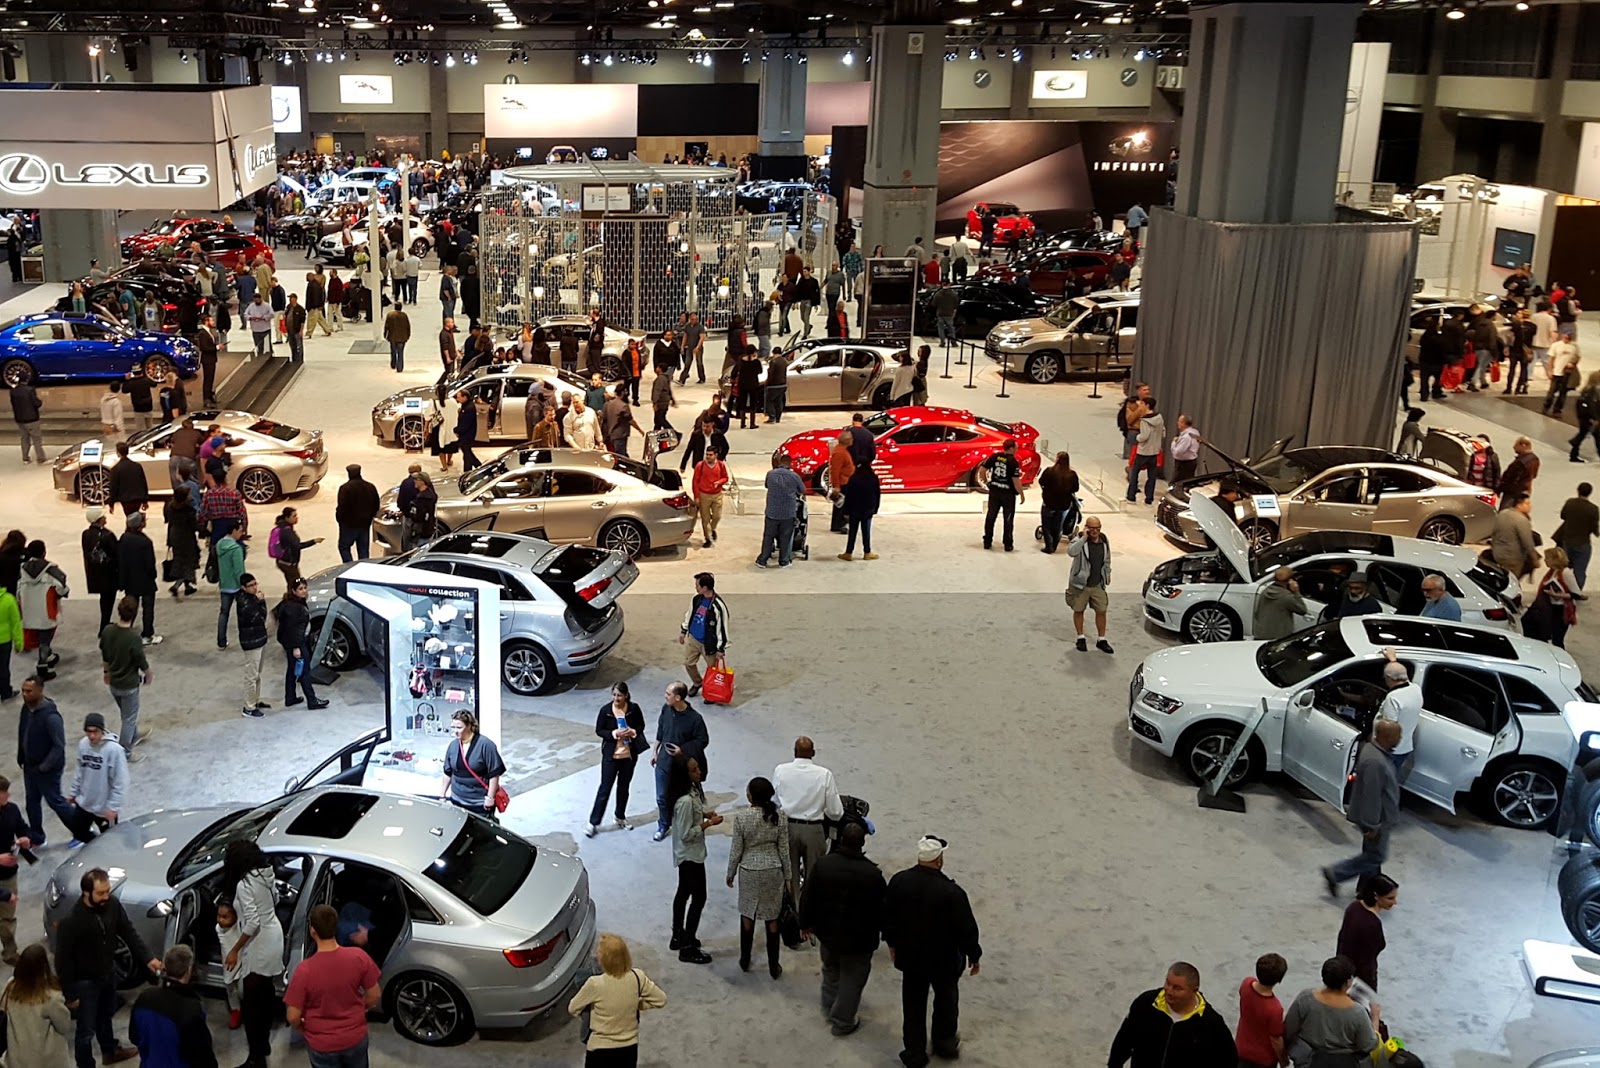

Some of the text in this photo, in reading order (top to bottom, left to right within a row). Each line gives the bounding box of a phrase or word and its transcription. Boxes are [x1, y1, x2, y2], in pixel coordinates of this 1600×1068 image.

[1093, 162, 1165, 172] INFINITI
[53, 163, 209, 187] LEXUS
[993, 466, 1007, 478] 43
[428, 588, 470, 598] collection
